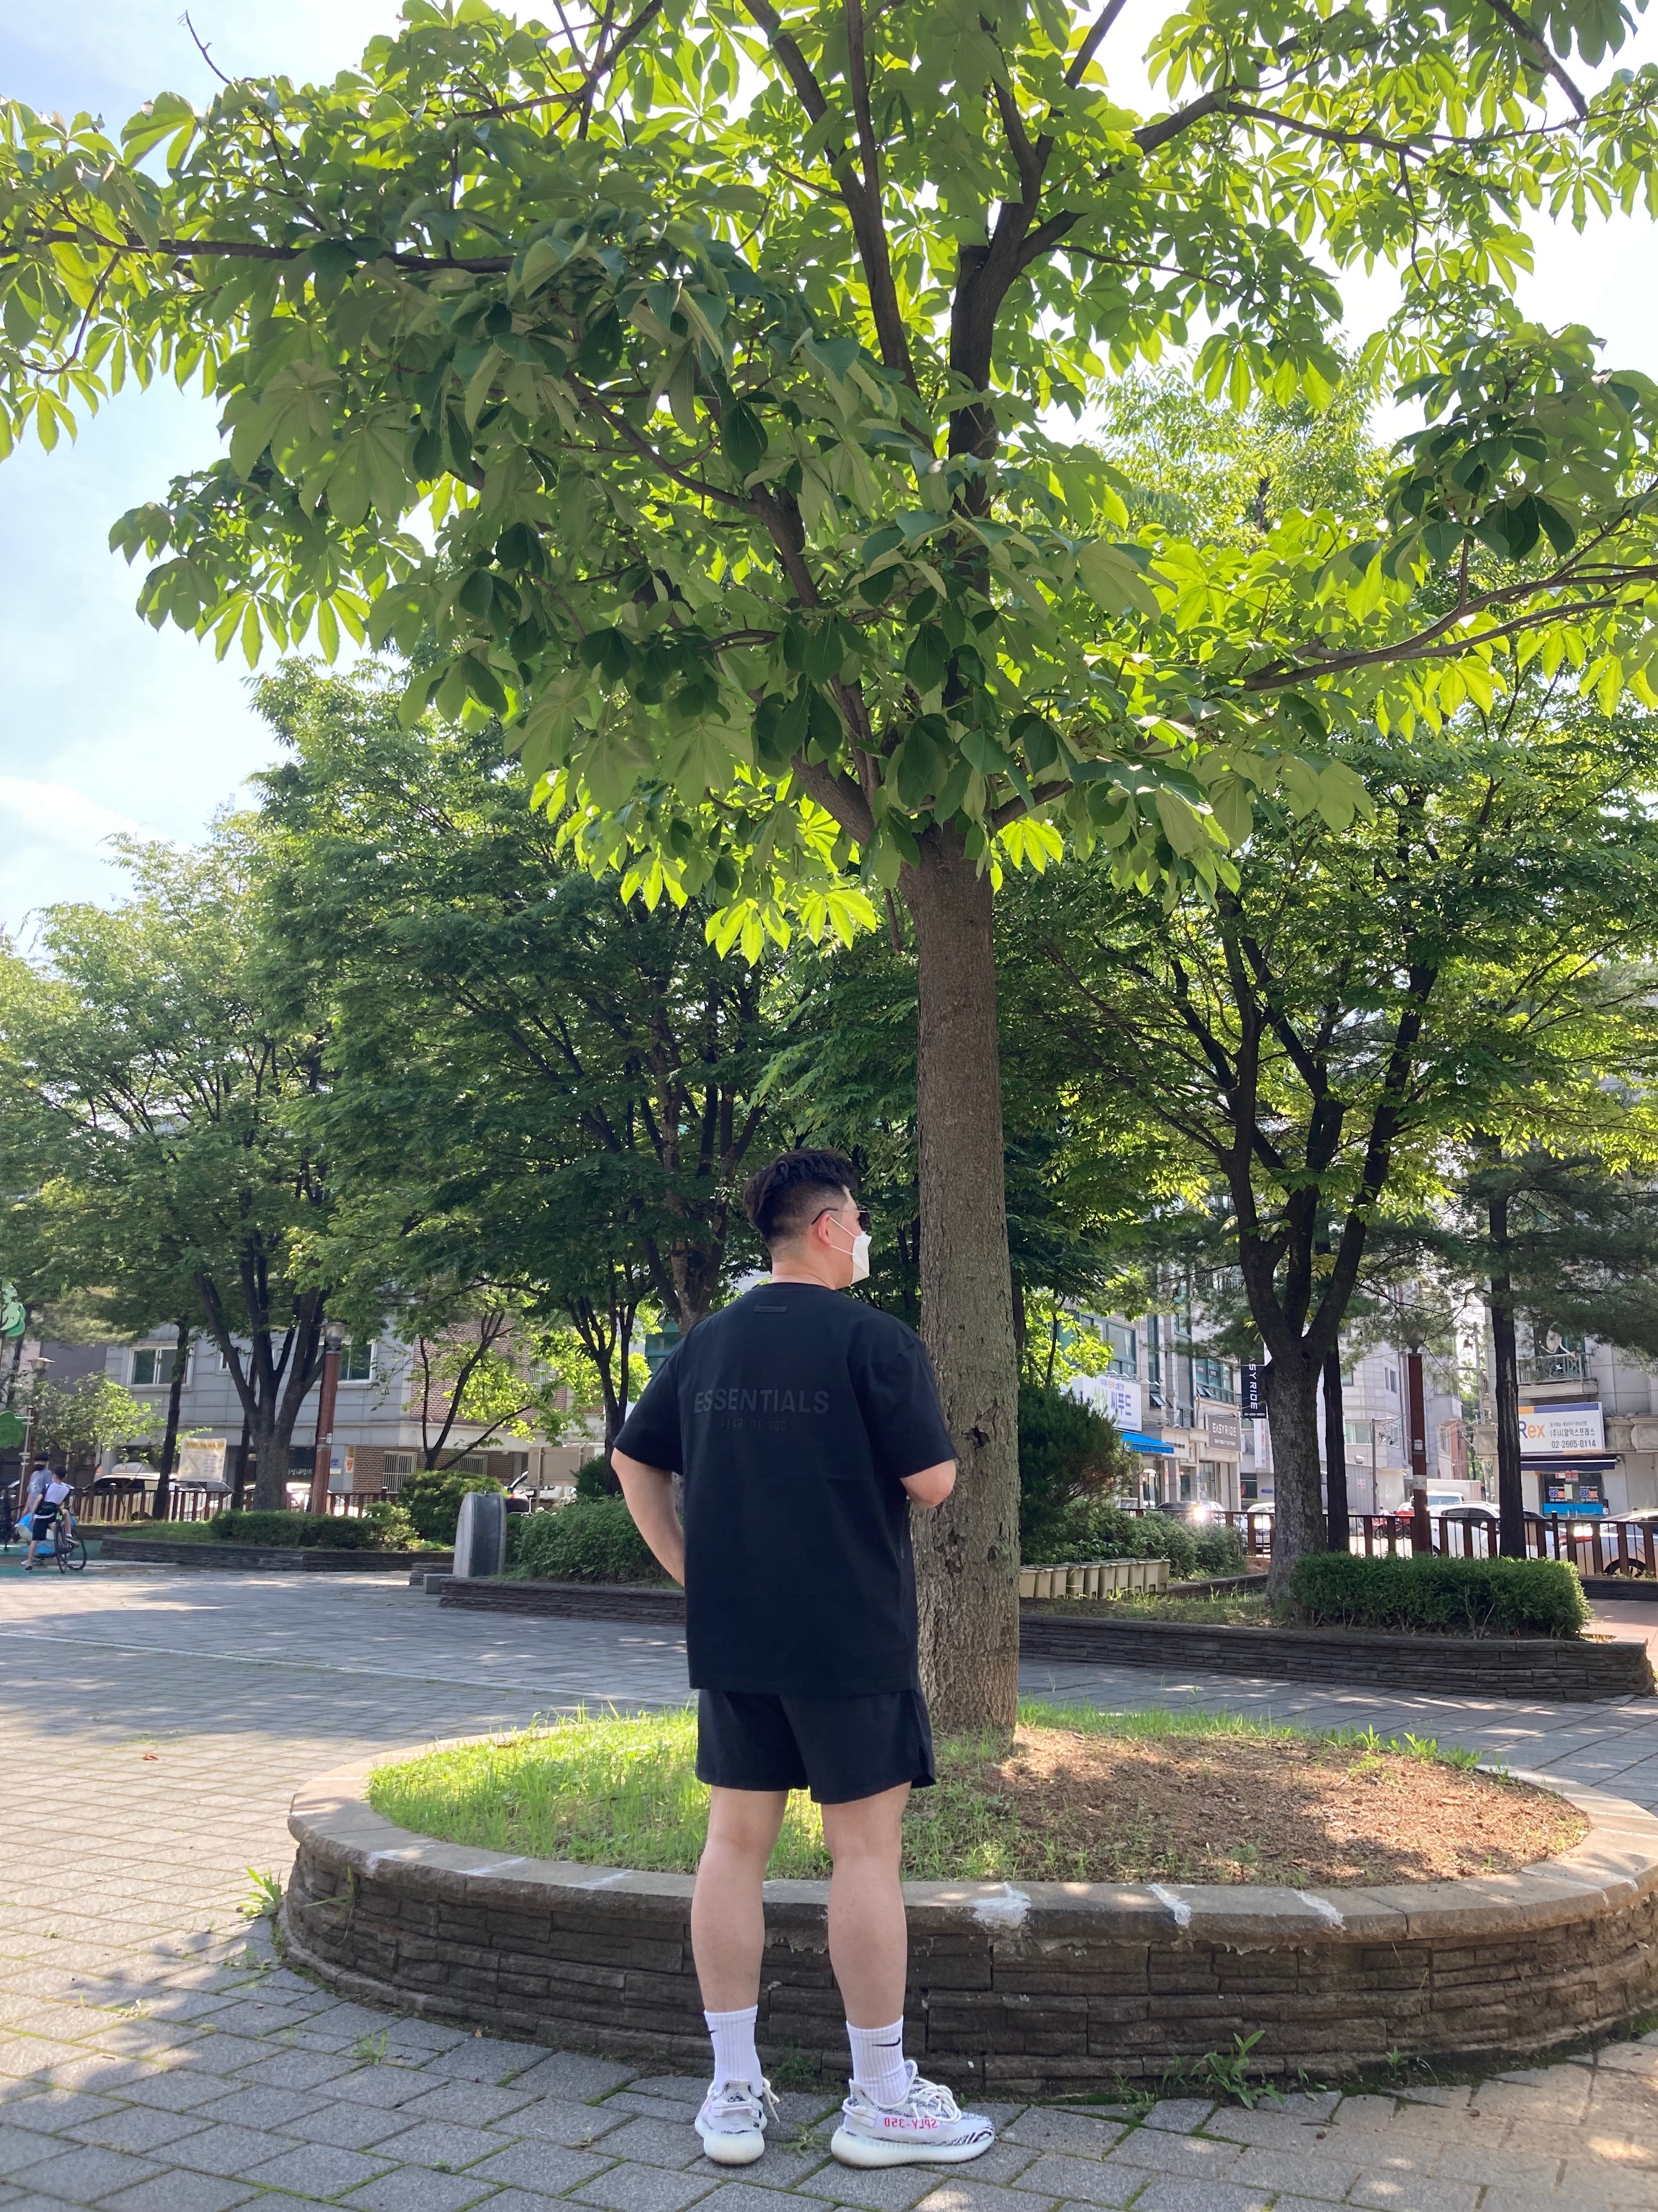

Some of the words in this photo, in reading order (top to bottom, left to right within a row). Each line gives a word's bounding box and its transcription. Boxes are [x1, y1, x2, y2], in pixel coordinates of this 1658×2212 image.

[693, 1388, 831, 1414] ESSENTIALS
[749, 1419, 763, 1430] OF
[1212, 1423, 1237, 1437] EASYRIDE
[1552, 1440, 1596, 1448] 02-2665-0114
